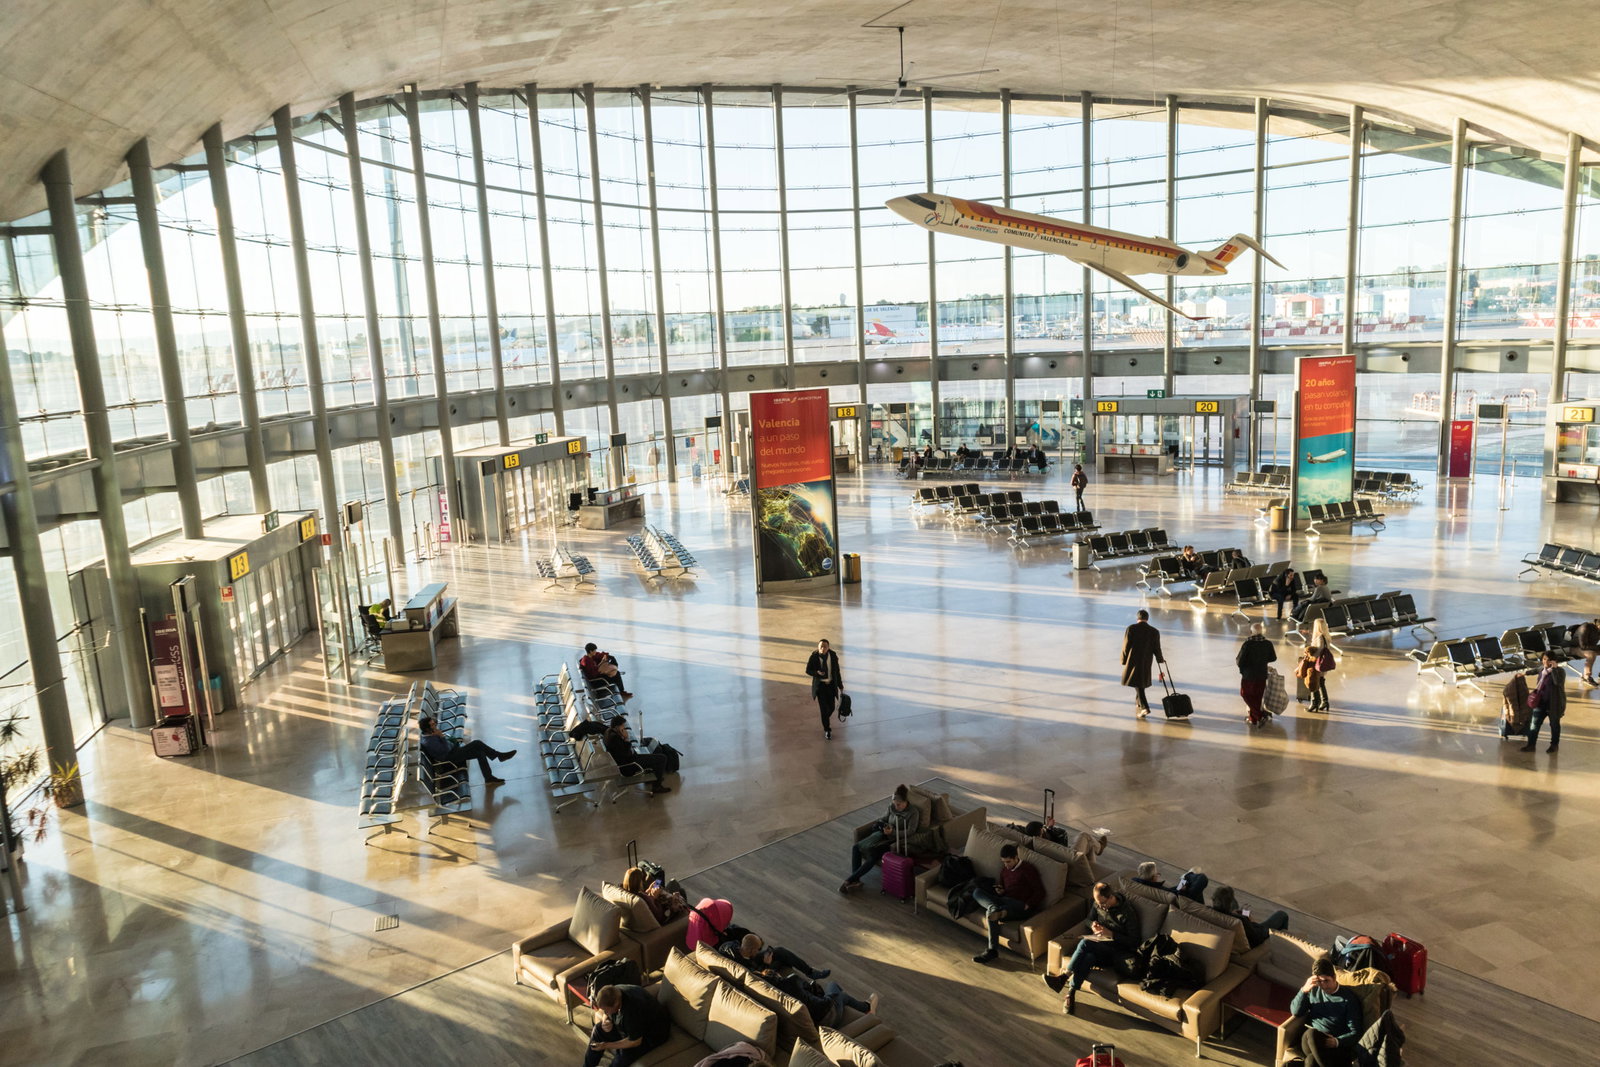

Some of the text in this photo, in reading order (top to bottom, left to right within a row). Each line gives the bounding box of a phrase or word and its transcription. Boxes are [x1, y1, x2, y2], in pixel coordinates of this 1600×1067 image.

[1004, 228, 1034, 238] COMUNITAT
[1305, 378, 1335, 387] 20 años
[1304, 392, 1324, 400] pasan
[841, 408, 851, 416] 18
[1102, 403, 1113, 411] 19
[1200, 403, 1213, 411] 20
[1570, 409, 1585, 420] 21
[759, 418, 800, 428] Valencia
[780, 433, 800, 442] paso
[571, 442, 578, 452] 16
[760, 445, 806, 456] del mundo
[507, 455, 516, 467] 15
[305, 521, 312, 537] 14
[234, 555, 246, 576] 13
